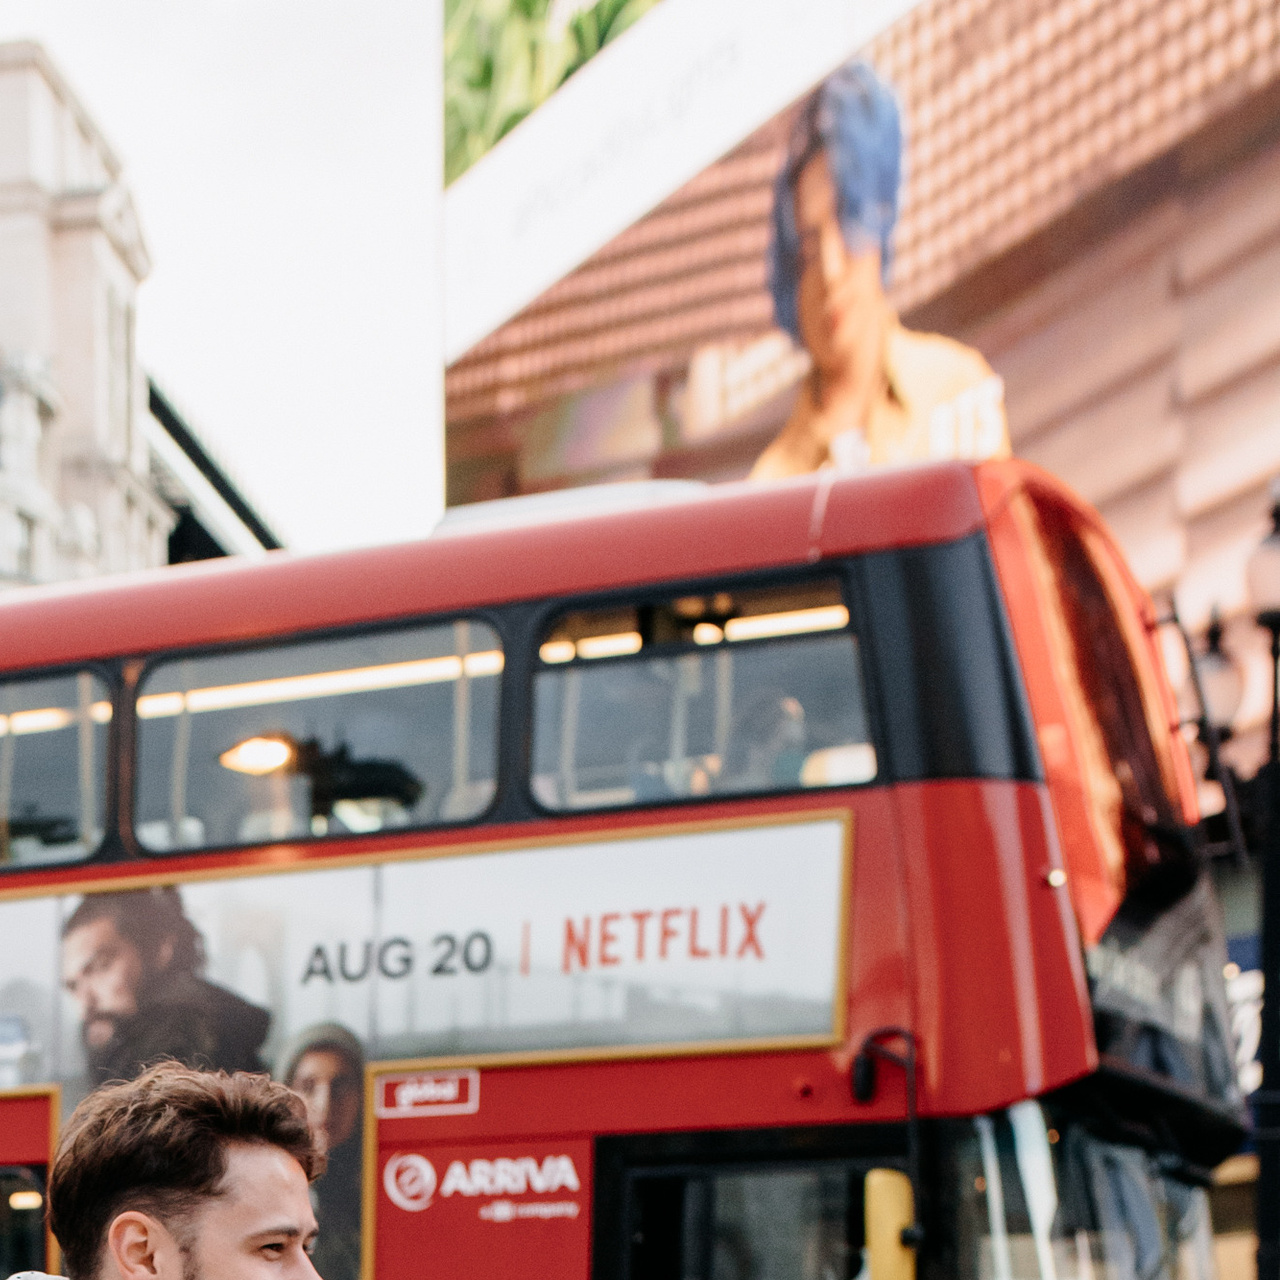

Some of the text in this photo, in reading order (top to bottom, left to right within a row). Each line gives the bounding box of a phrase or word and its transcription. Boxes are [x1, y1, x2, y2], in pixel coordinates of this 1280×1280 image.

[302, 930, 495, 985] AUG 20
[561, 899, 768, 976] NETFLIX
[438, 1153, 581, 1198] ARRIVA
